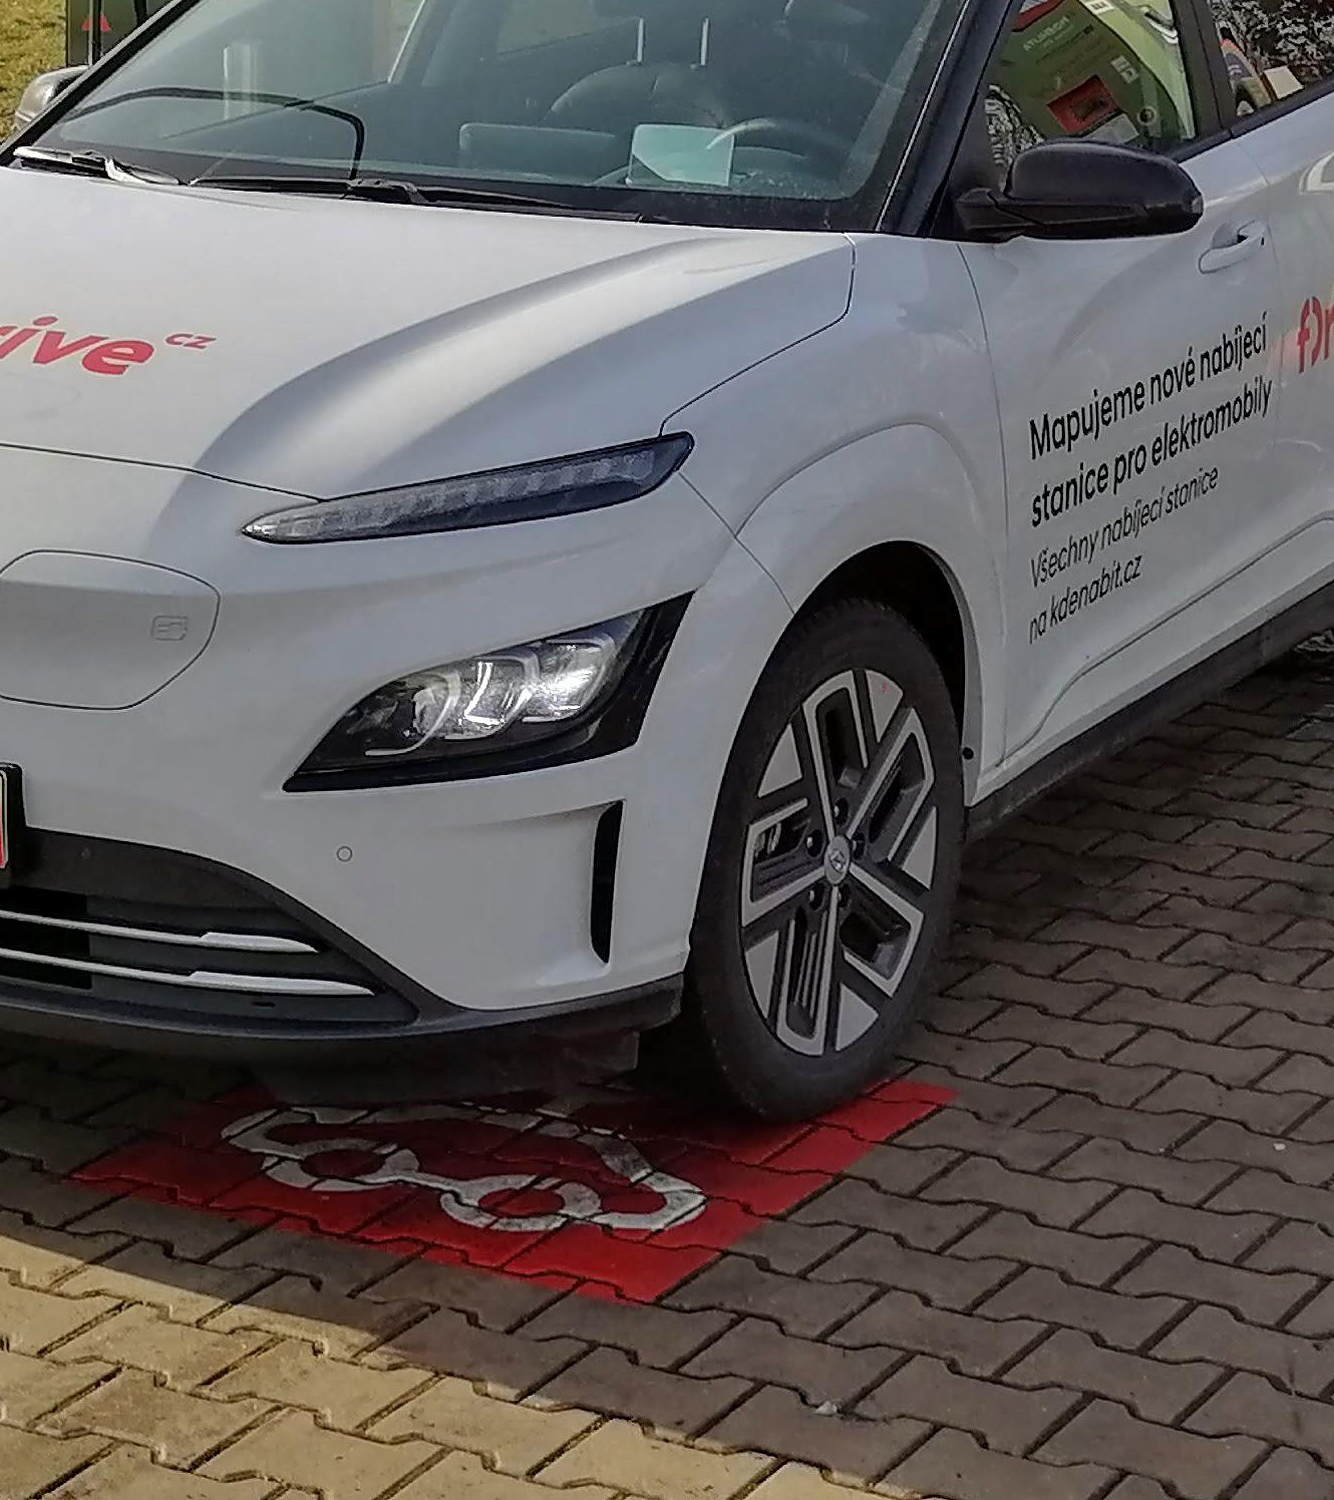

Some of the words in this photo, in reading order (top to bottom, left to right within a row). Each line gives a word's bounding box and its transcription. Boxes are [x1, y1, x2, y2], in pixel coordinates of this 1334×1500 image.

[1029, 382, 1145, 460] Mapujeme
[1150, 346, 1196, 405] nové
[1200, 310, 1268, 381] nabíjecí
[1031, 462, 1109, 528] stanice
[1114, 445, 1147, 495] pro
[1151, 374, 1273, 466] elektromobily
[1030, 530, 1099, 588] Všechny
[1100, 485, 1165, 550] nabíjecí
[1165, 466, 1219, 514] stanice
[1029, 610, 1047, 645] na
[1049, 554, 1143, 628] kdenabit.cz
